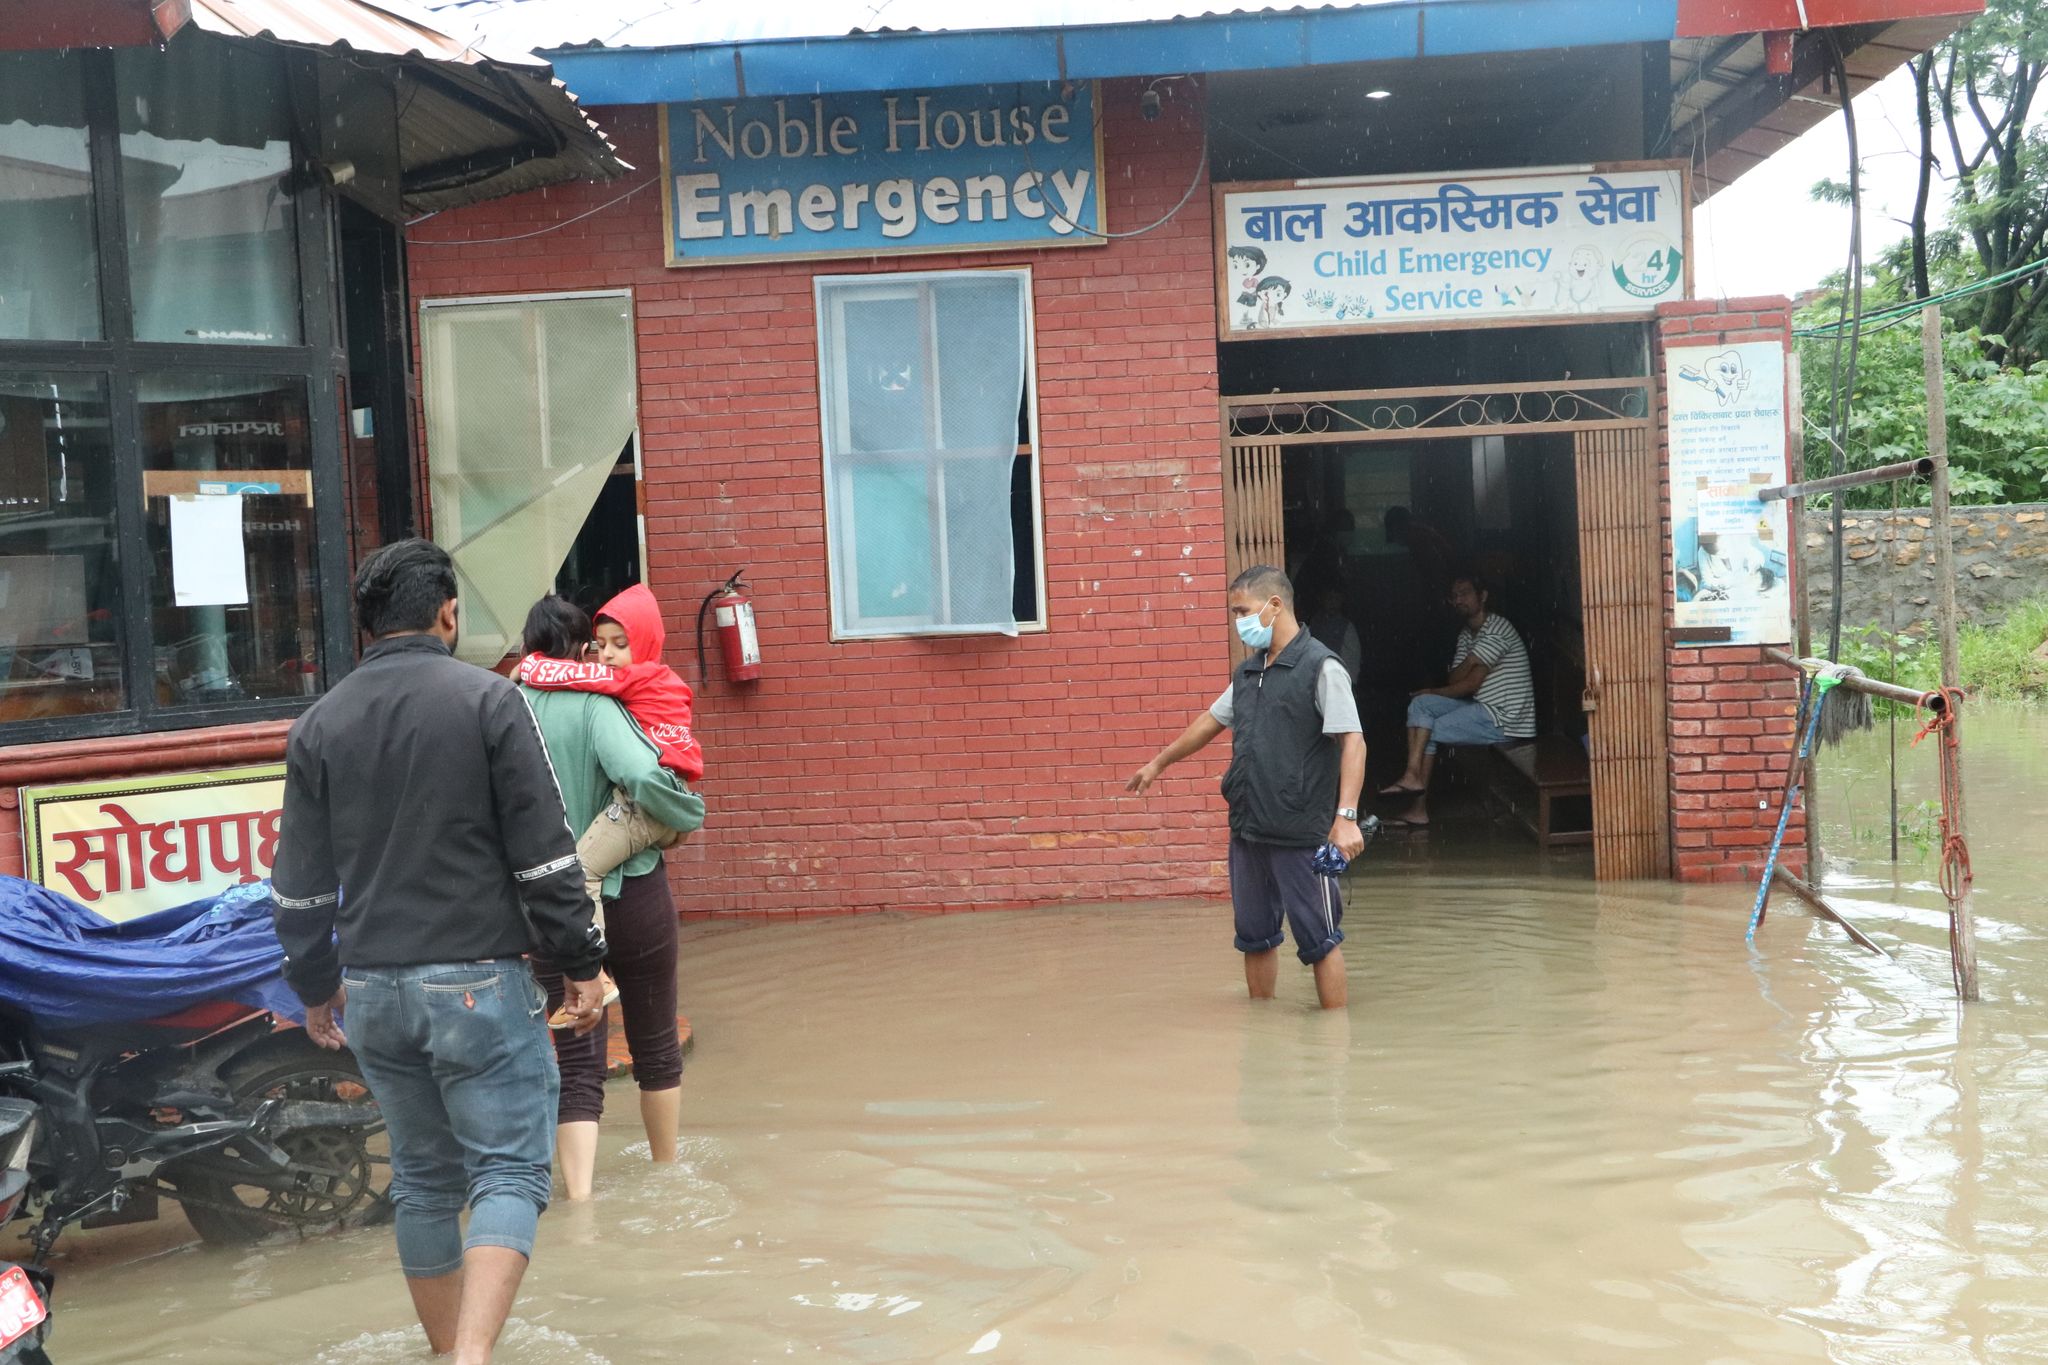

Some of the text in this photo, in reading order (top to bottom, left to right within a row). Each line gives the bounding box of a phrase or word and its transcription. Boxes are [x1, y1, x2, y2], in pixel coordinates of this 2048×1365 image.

[691, 95, 1070, 163] Noble House
[675, 168, 1091, 240] Emergency
[1241, 176, 1660, 243] बाल आकस्मिक सेवा
[1313, 246, 1553, 278] Child Emergency
[1624, 280, 1671, 297] SERVICES
[1641, 273, 1657, 284] hr
[1385, 283, 1484, 313] Service
